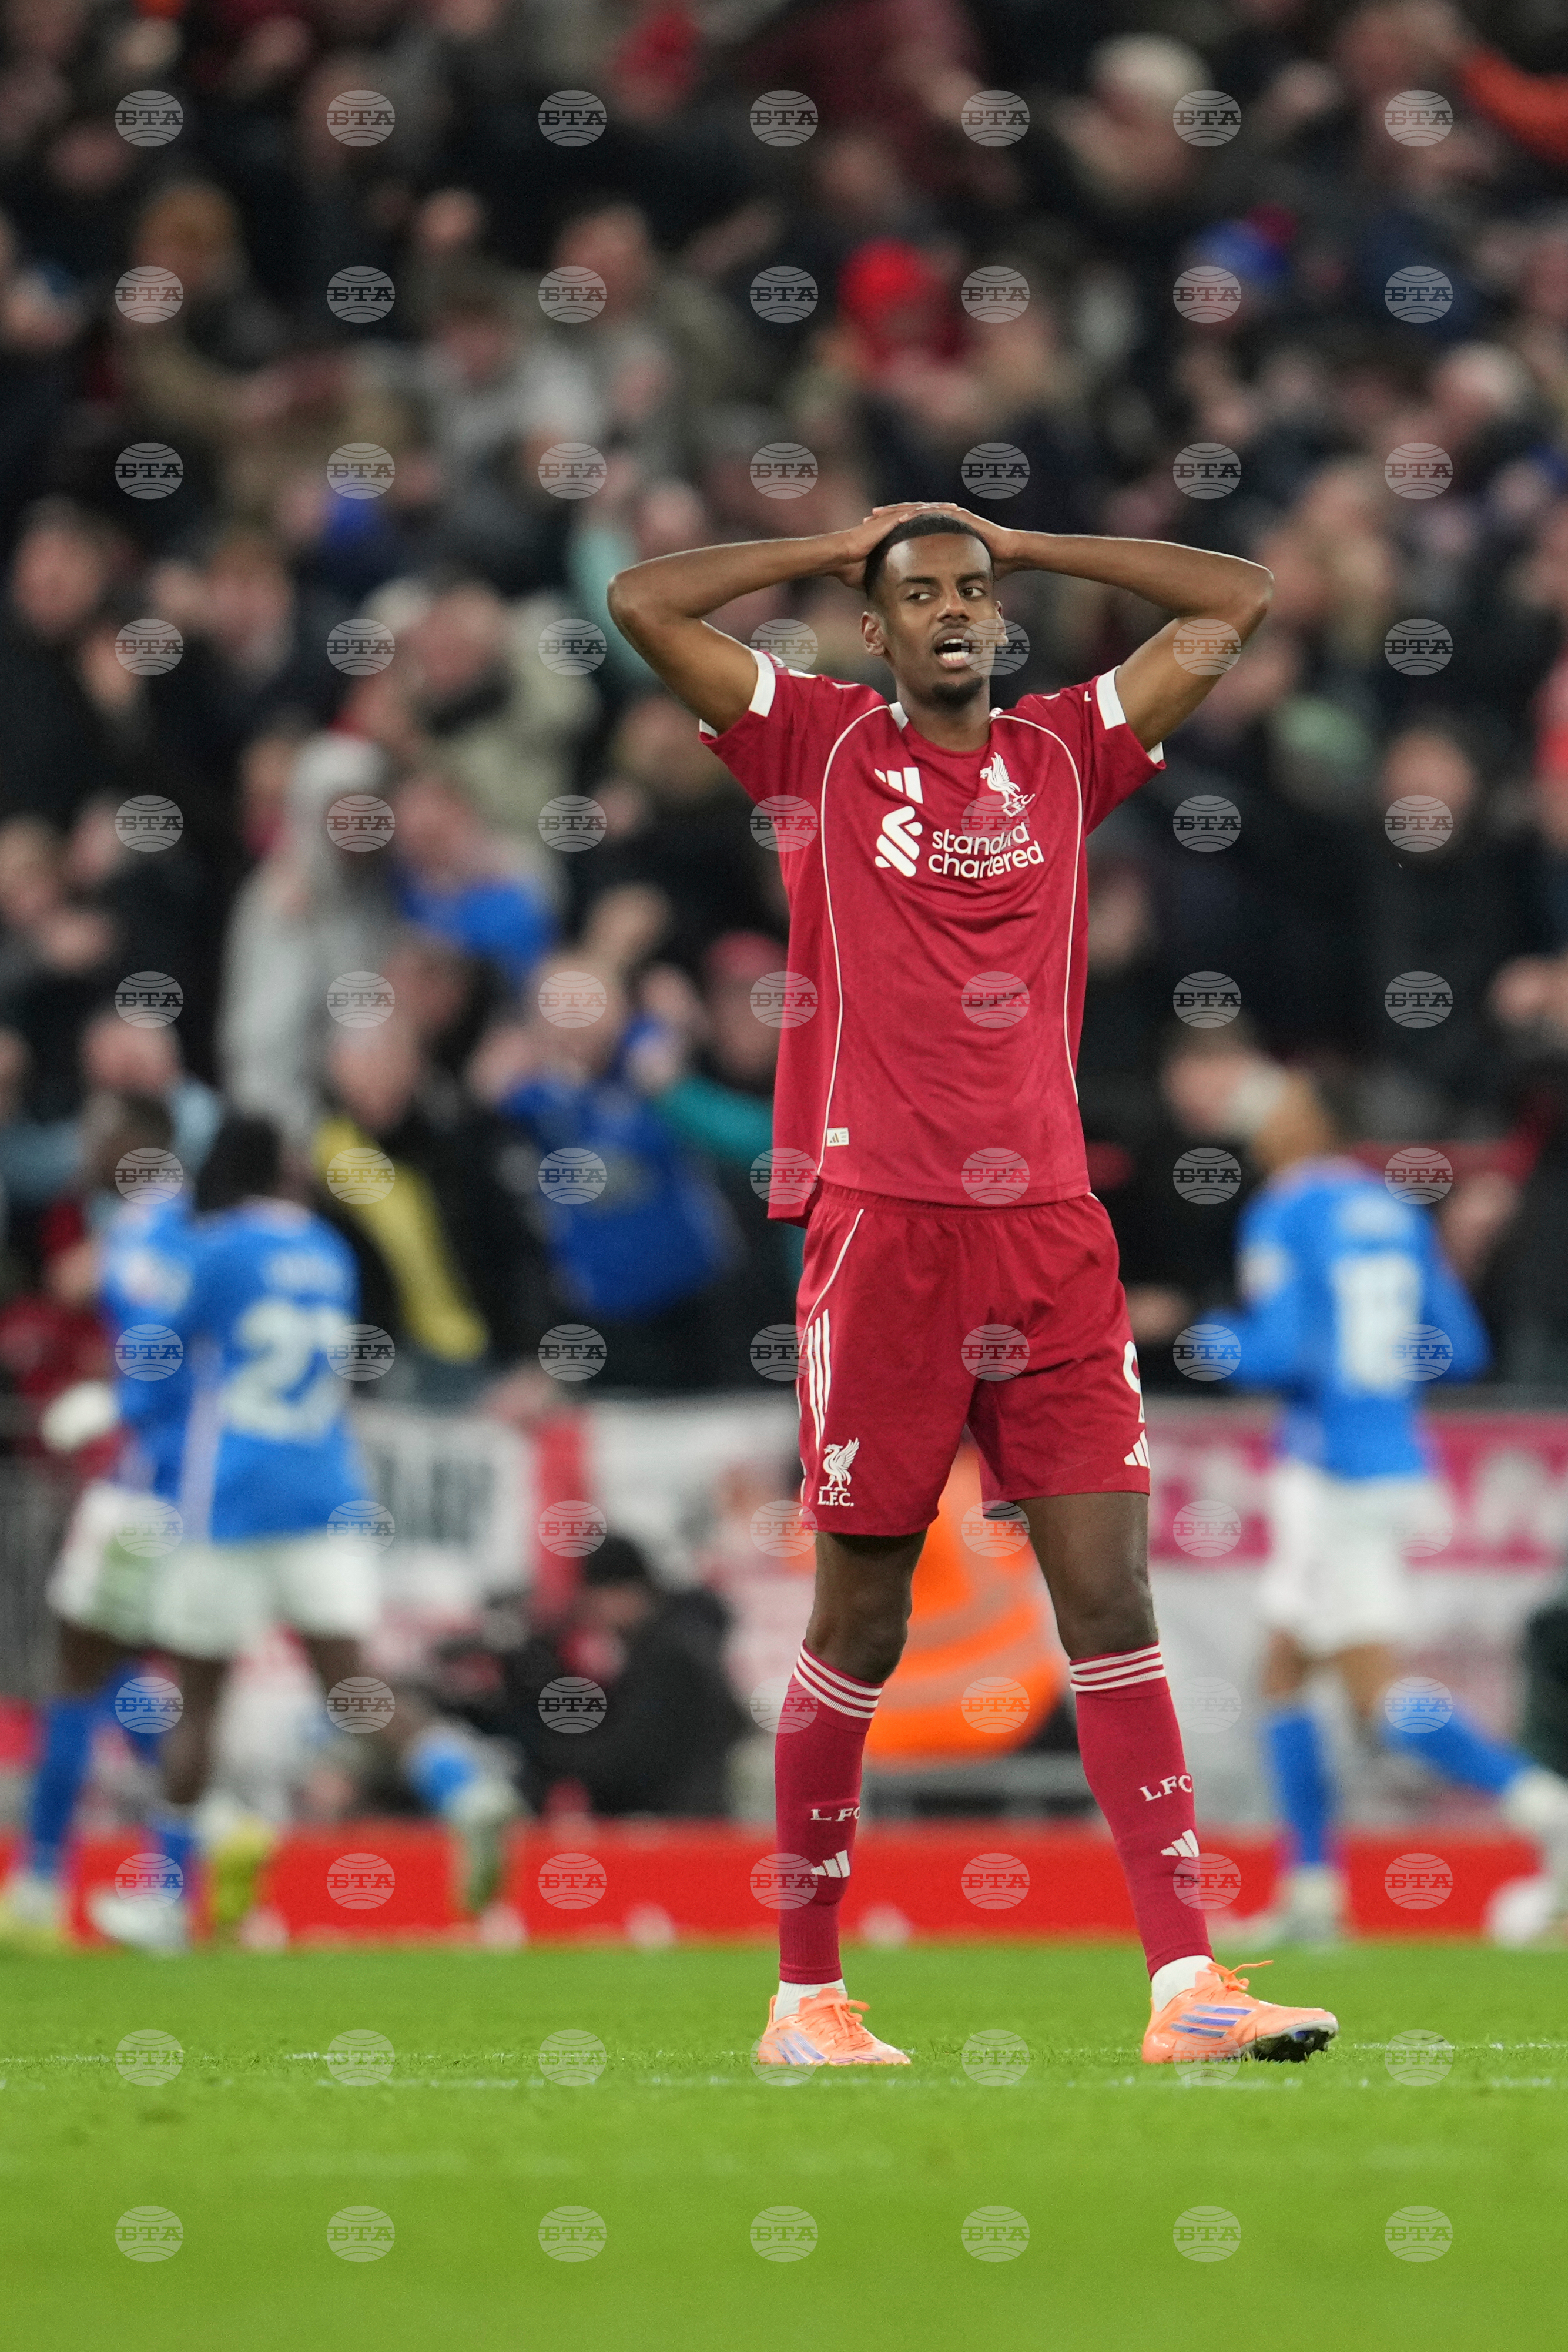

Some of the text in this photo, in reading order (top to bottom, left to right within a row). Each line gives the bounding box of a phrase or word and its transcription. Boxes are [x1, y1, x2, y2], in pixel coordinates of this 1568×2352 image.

[928, 840, 1044, 879] chartered
[817, 1490, 855, 1507] L.F.C.
[1139, 1775, 1192, 1801] LFC
